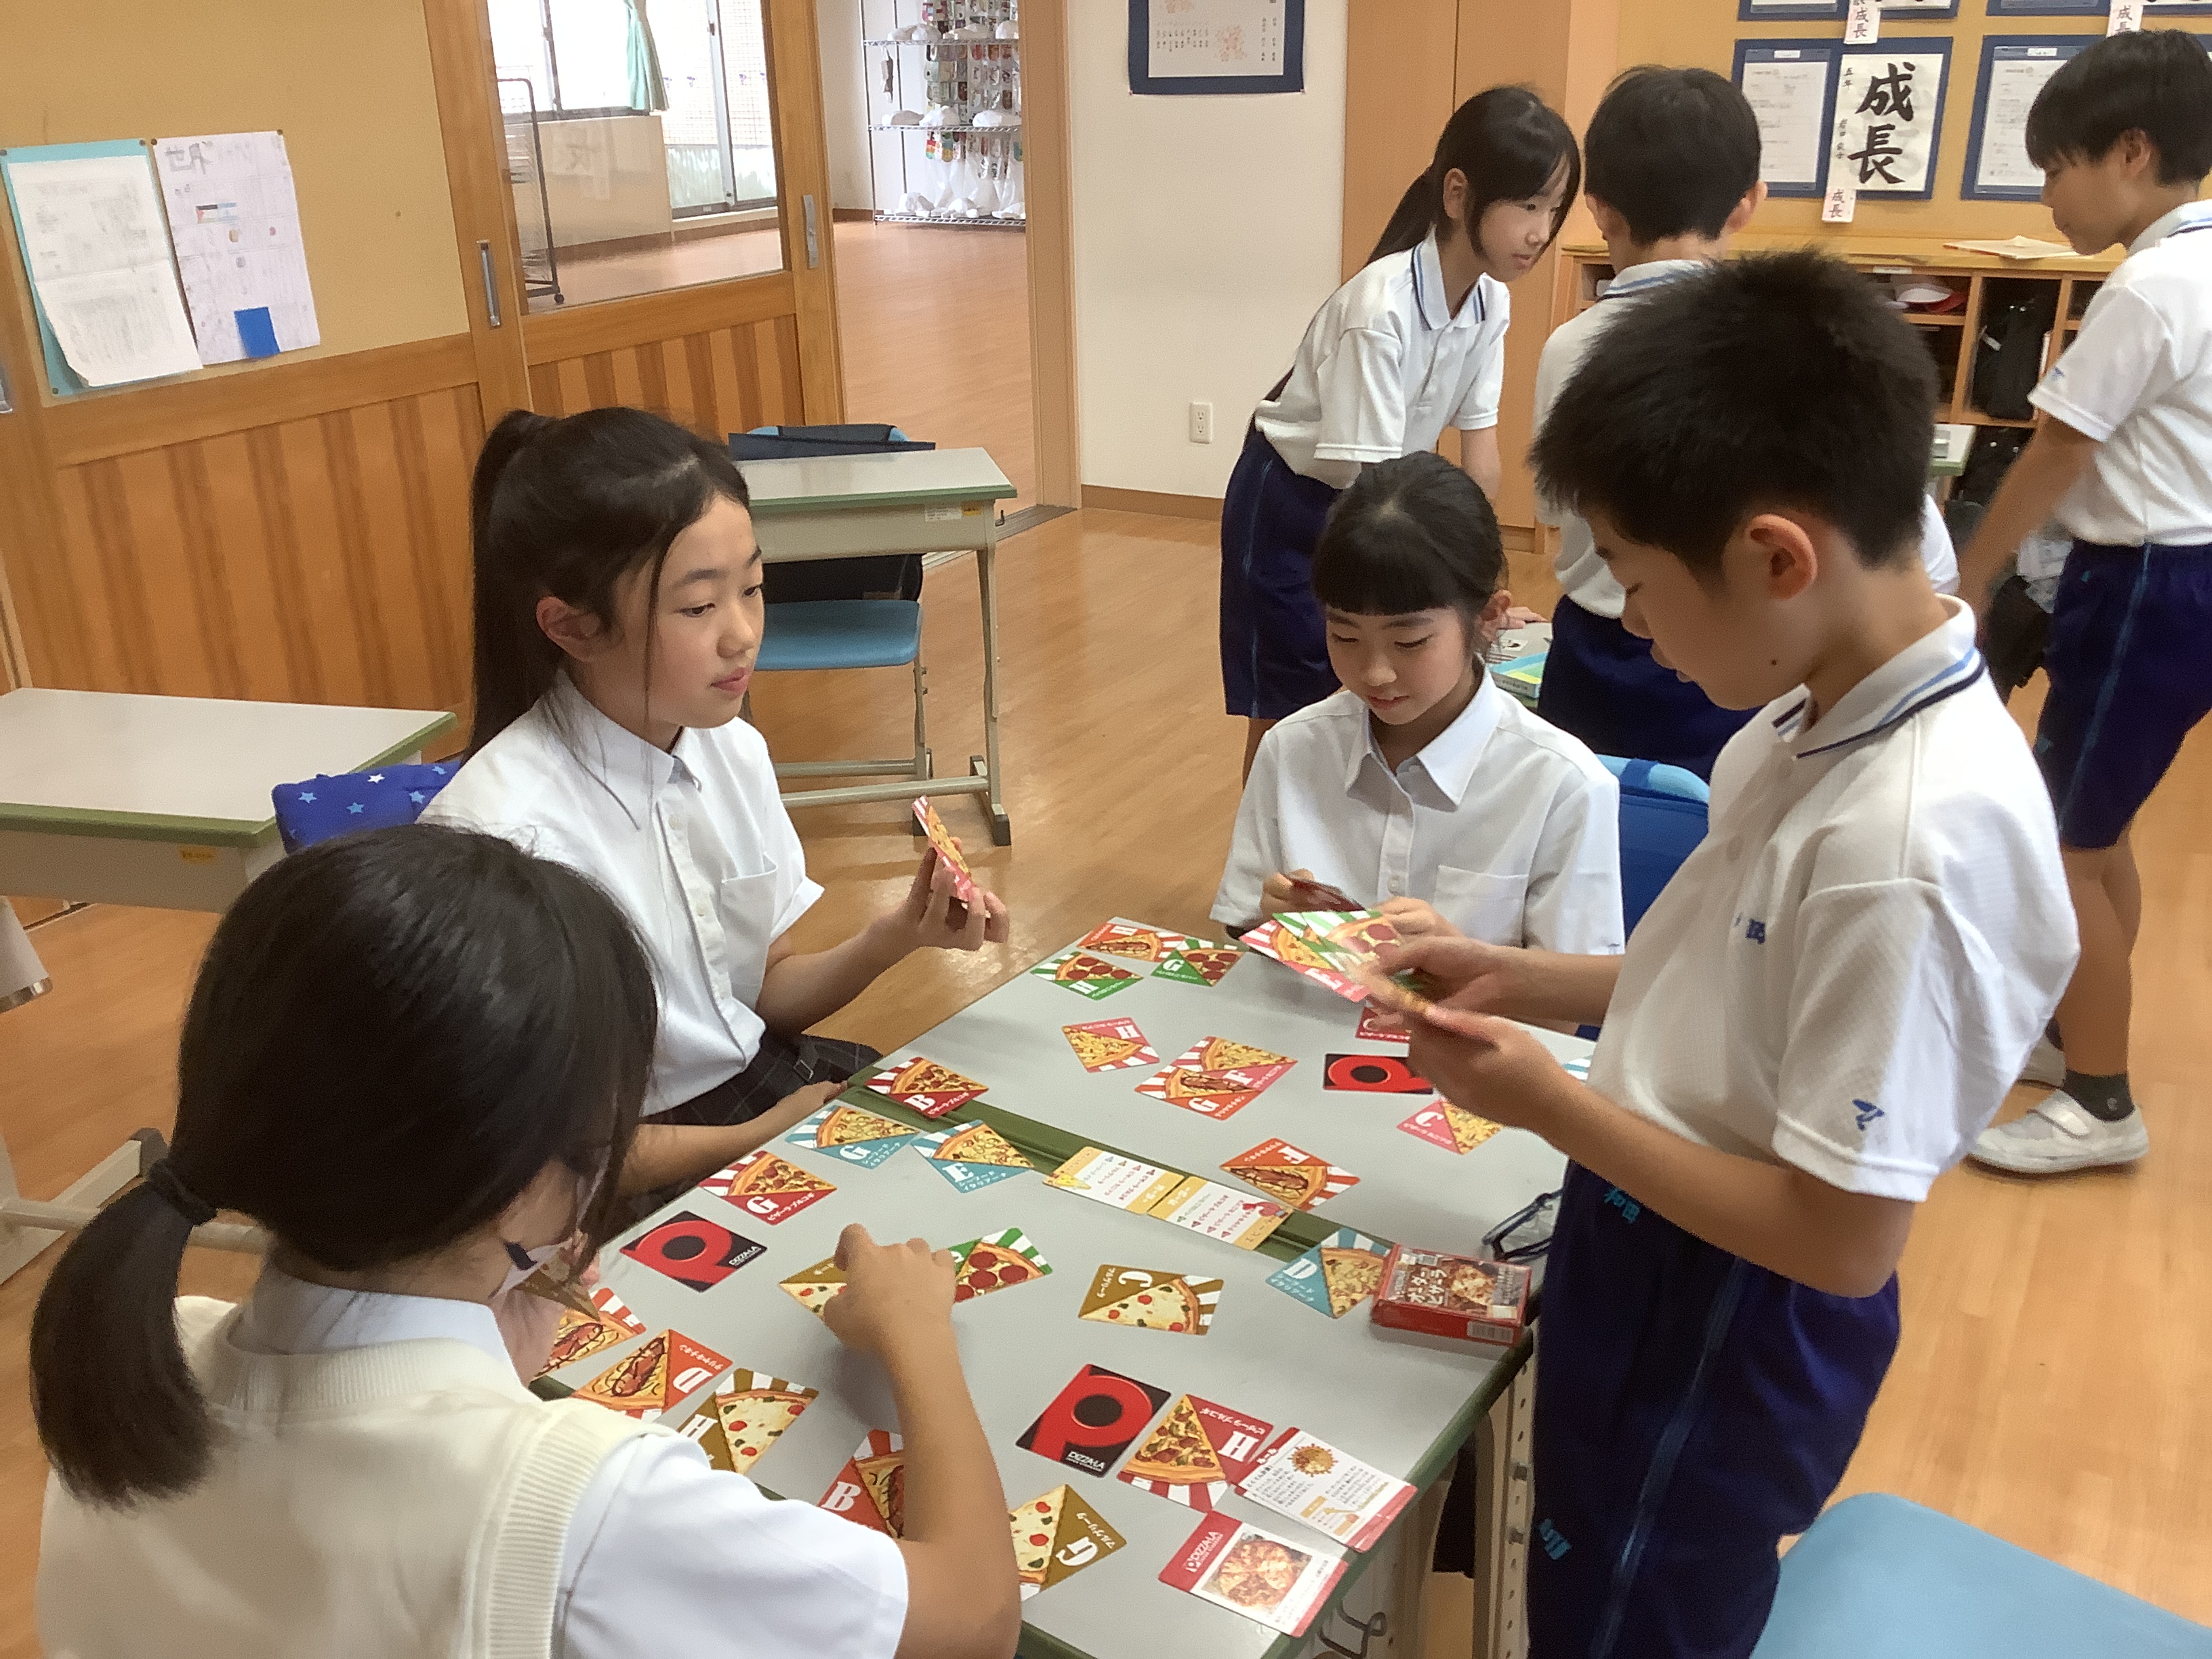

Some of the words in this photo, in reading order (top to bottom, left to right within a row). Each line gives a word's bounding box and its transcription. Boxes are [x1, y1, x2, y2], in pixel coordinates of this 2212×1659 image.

[1847, 62, 1917, 184] 成長
[1828, 189, 1845, 218] 成長
[1109, 924, 1139, 937] H
[1162, 958, 1185, 972] G
[1068, 980, 1099, 994] H
[1115, 1025, 1141, 1039] H
[1222, 1069, 1254, 1085] F
[903, 1094, 937, 1111] B
[1188, 1097, 1220, 1112] G
[1414, 1111, 1444, 1128] C
[839, 1145, 871, 1160] G
[1277, 1144, 1311, 1164] F
[943, 1162, 975, 1183] E
[746, 1196, 779, 1214] G
[1283, 1258, 1317, 1279] D
[1118, 1269, 1153, 1289] C
[673, 1367, 713, 1393] D
[678, 1414, 718, 1442] H
[1217, 1431, 1259, 1462] H
[1069, 1450, 1105, 1469] PIZZA-LA
[820, 1481, 861, 1512] B
[1055, 1536, 1099, 1567] G
